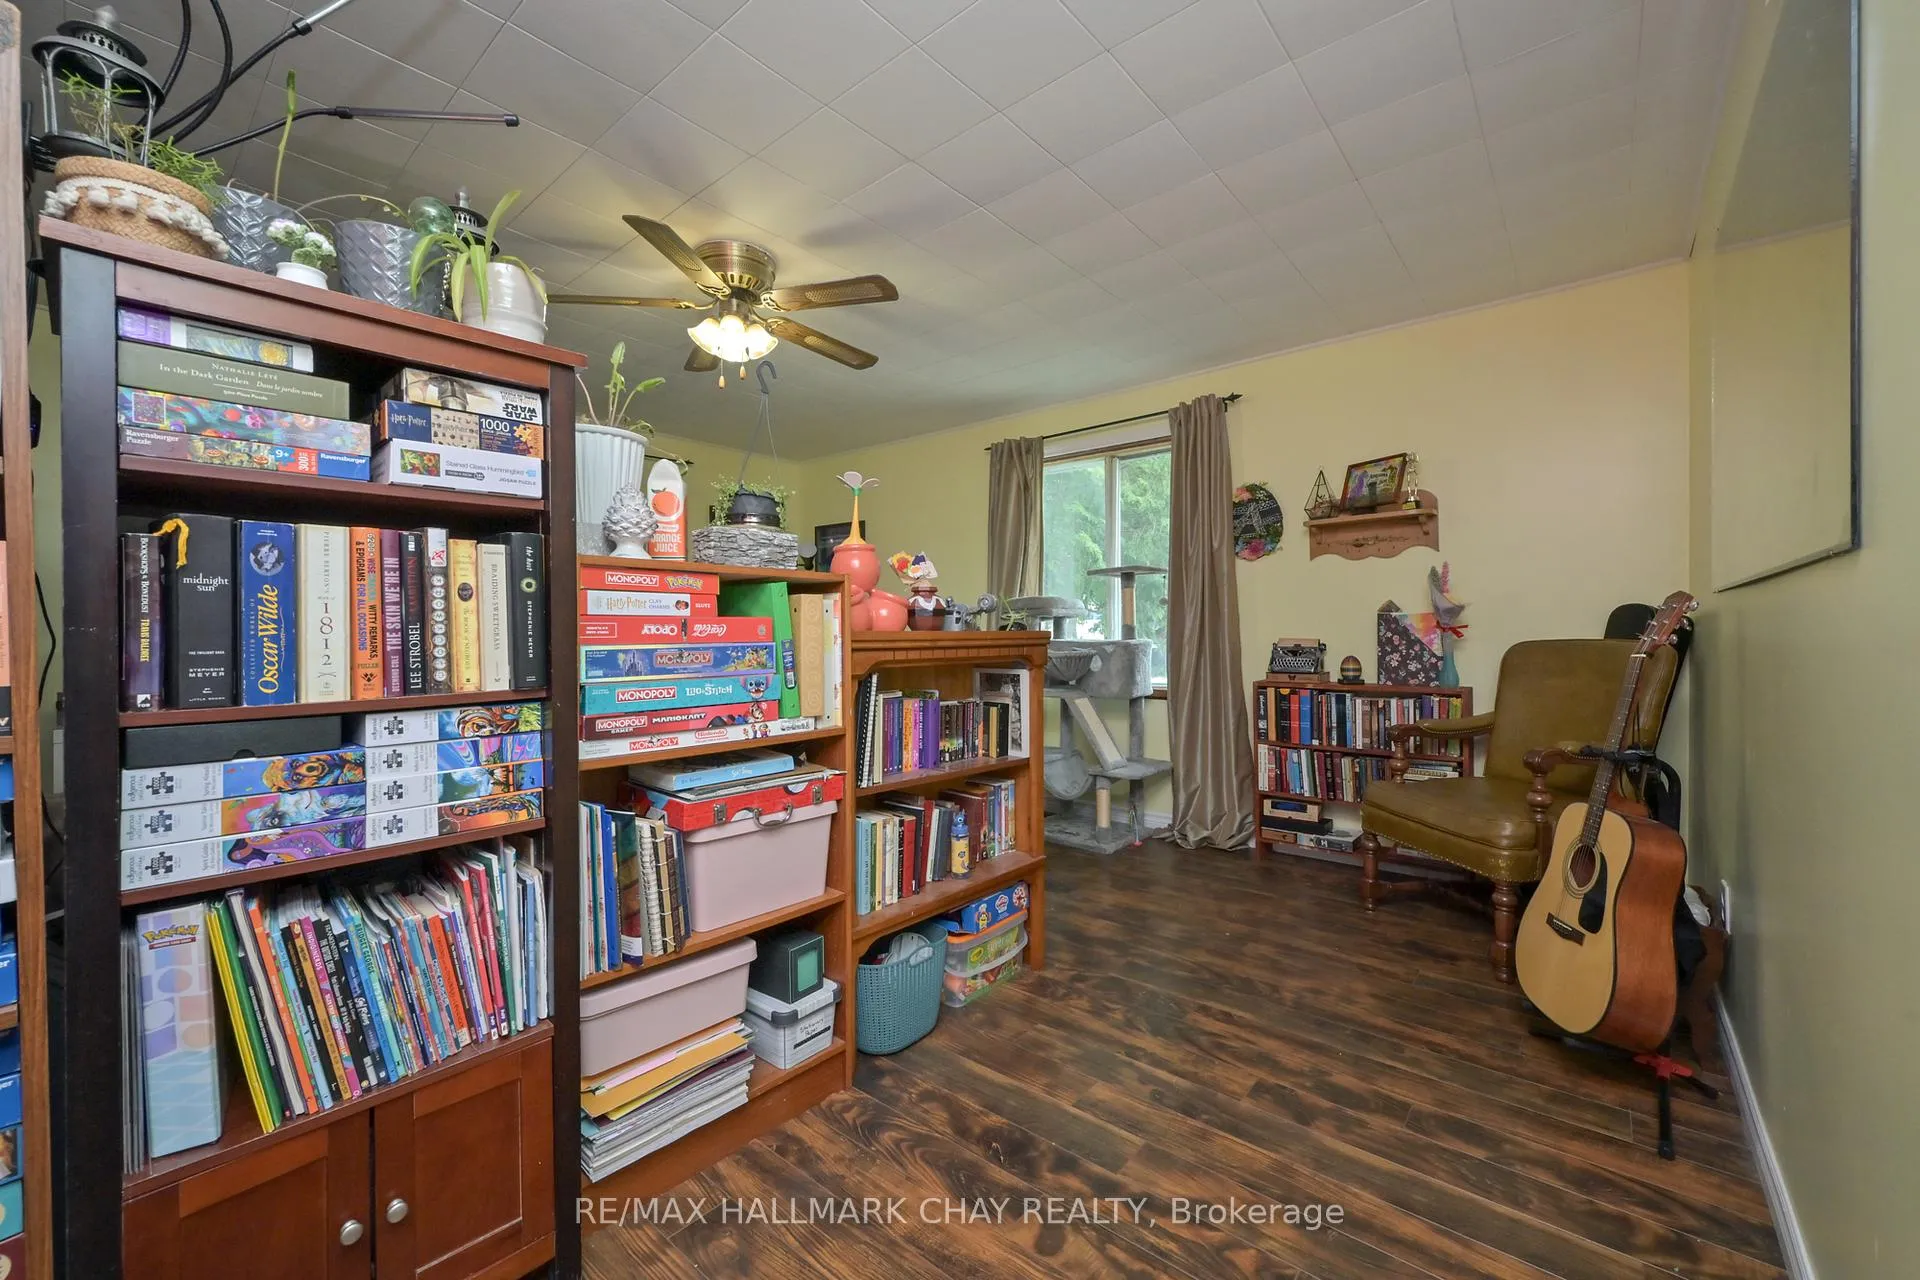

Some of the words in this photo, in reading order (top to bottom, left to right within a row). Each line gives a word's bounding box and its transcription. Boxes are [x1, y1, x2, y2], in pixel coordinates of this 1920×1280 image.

[159, 363, 169, 372] In
[174, 365, 188, 374] the
[191, 369, 213, 379] Dark
[215, 374, 249, 385] Garden
[211, 363, 255, 377] NATHALIE
[256, 381, 273, 390] Dans
[280, 386, 300, 395] jardin
[502, 403, 537, 414] WARS
[502, 410, 537, 421] STAR
[391, 414, 408, 425] Harry
[408, 415, 427, 428] Potter
[480, 418, 510, 432] 1000
[126, 429, 179, 443] Ravensburger
[126, 437, 152, 446] Puzzle
[275, 449, 289, 457] 9+
[320, 453, 366, 464] Ravensburger
[446, 461, 468, 469] Stained
[654, 543, 679, 552] JUICE
[140, 537, 149, 574] BOOKSHOPS
[384, 556, 399, 568] IN
[356, 546, 366, 582] EPIGRAMS
[183, 573, 229, 585] midnight
[607, 574, 657, 585] MONOPOLY
[197, 584, 215, 592] sun
[357, 583, 367, 597] FOR
[384, 571, 401, 602] WE'RE
[141, 580, 149, 613] BONEDUST
[257, 584, 279, 638] Wilde
[357, 598, 367, 610] ALL
[607, 597, 625, 611] Harry
[627, 597, 647, 609] Potter
[368, 604, 377, 625] WITTY
[385, 605, 402, 629] SKIN
[140, 619, 149, 638] TRAVIS
[358, 612, 368, 651] OCCASIONS
[492, 601, 500, 650] SWEETGRASS
[641, 624, 677, 635] OPOLY
[369, 625, 379, 660] REMARKS,
[386, 632, 402, 651] THE
[409, 622, 421, 668] STROBEL
[140, 639, 150, 662] BALDREE
[258, 638, 279, 693] Oscar
[391, 655, 400, 668] COLE
[391, 669, 400, 692] DESMOND
[410, 670, 422, 689] LEE
[618, 688, 675, 701] MONOPOLY
[598, 718, 646, 730] MONOPOLY
[697, 730, 726, 739] Nintendo
[318, 938, 328, 947] THE
[321, 923, 342, 960] FRANKENSTEIN
[351, 923, 369, 950] BRIDGET
[360, 949, 377, 974] GEORGE
[303, 931, 324, 970] INDIGINERDS
[320, 945, 333, 961] OUTSIDE
[325, 959, 337, 973] CIRCLE
